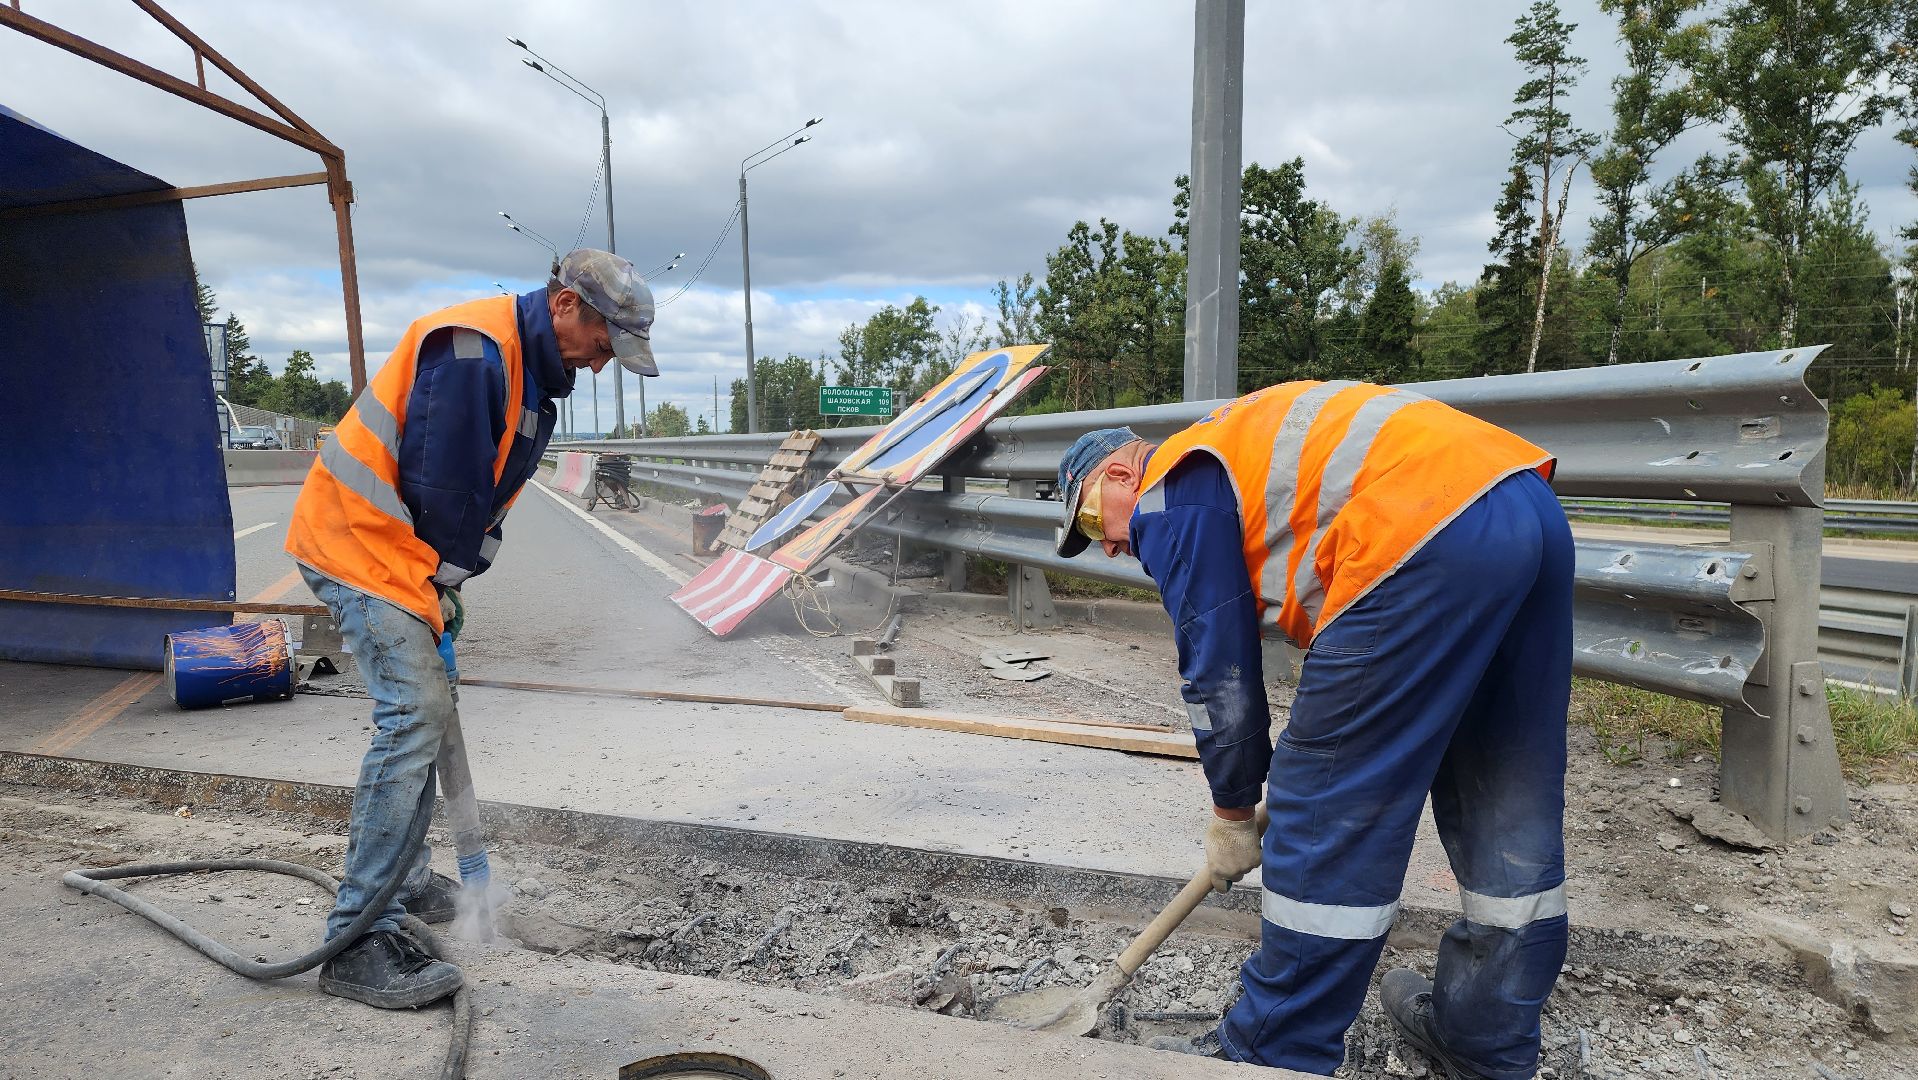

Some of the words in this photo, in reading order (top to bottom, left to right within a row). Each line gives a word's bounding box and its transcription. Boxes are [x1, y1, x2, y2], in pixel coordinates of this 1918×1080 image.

[822, 388, 874, 397] ВОЛОКОЛАМСК
[827, 397, 871, 405] ШАХОВСКАЯ
[878, 398, 890, 406] 109
